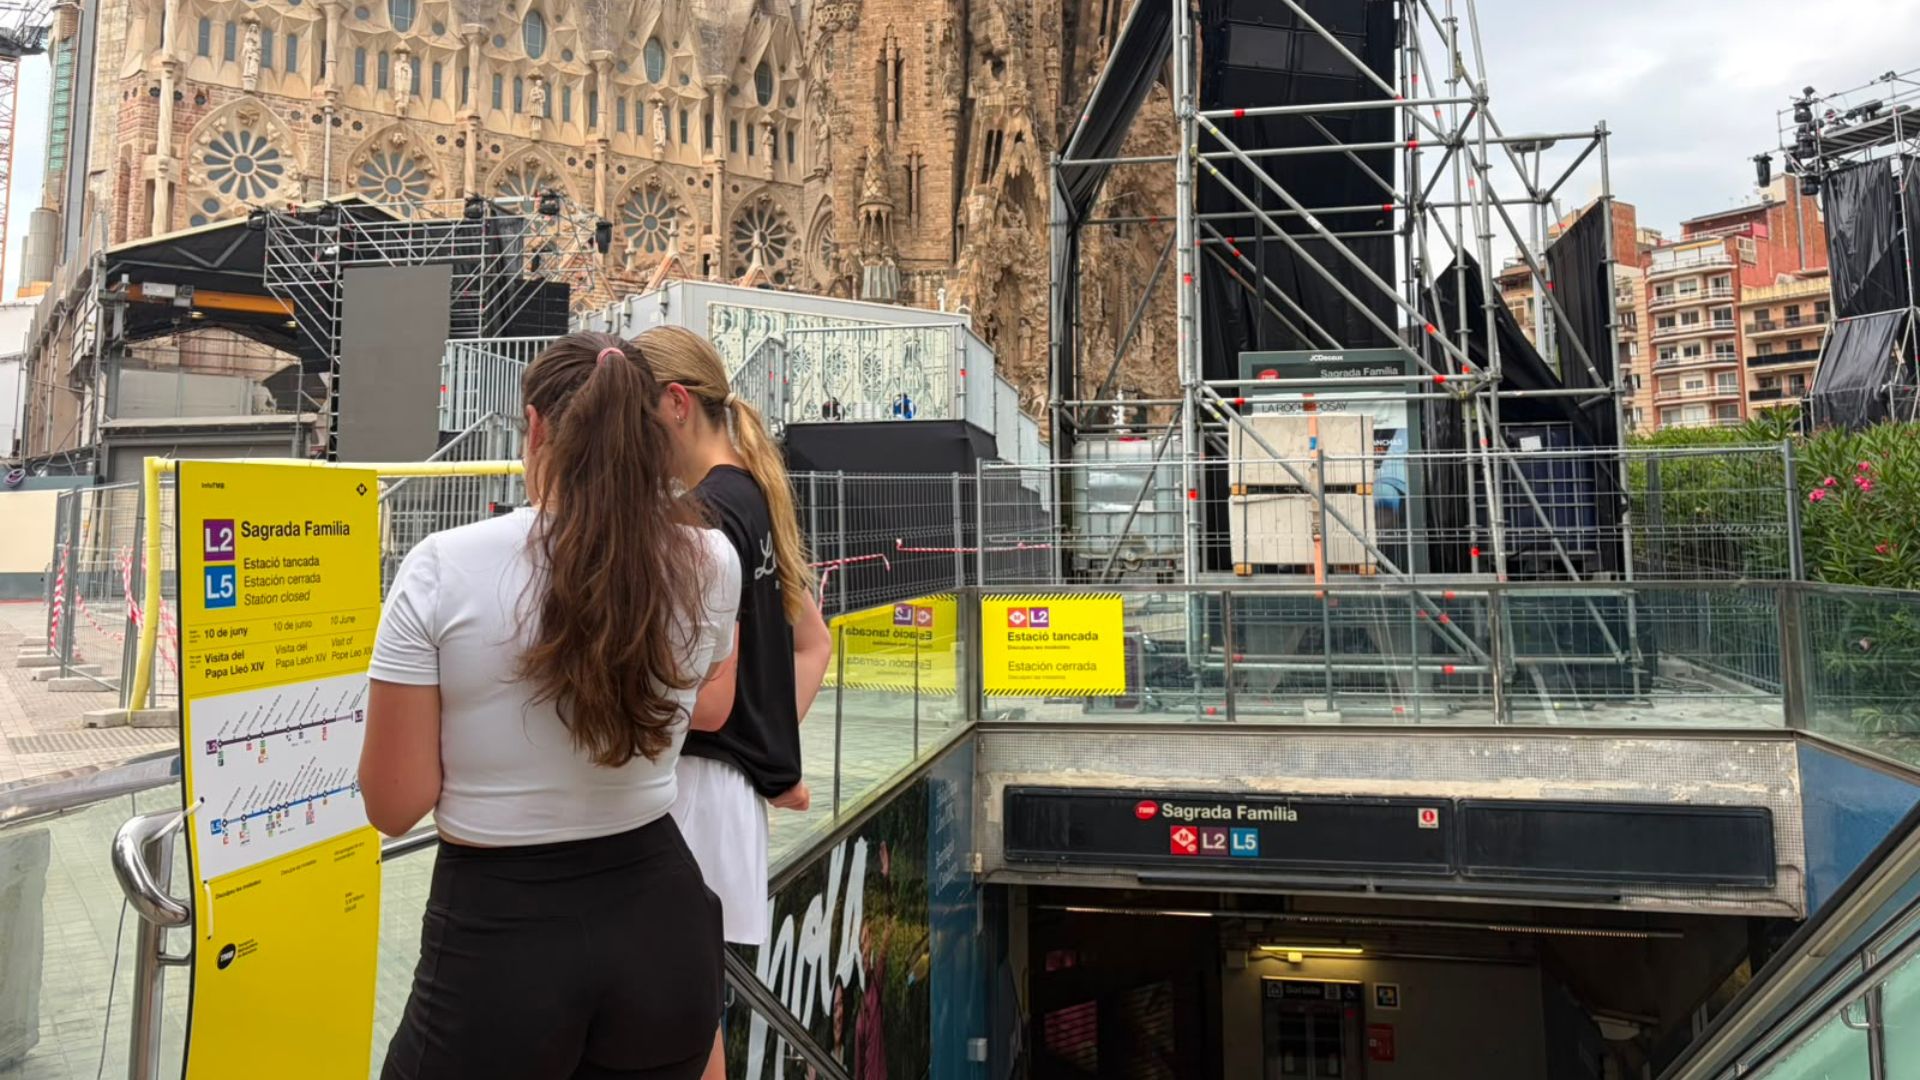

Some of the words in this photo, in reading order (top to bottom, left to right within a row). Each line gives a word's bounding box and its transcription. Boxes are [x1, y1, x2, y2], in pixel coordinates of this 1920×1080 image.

[241, 520, 300, 541] Sagrada
[205, 527, 233, 552] L2
[244, 556, 280, 570] Estació
[283, 555, 320, 568] tancada
[206, 573, 234, 599] L5
[244, 574, 285, 588] Estación
[288, 573, 321, 585] cerrada
[244, 592, 278, 606] Station
[281, 589, 311, 604] closed
[330, 615, 339, 625] 10
[340, 615, 356, 624] June
[1030, 610, 1048, 623] L2
[204, 628, 215, 639] 10
[217, 628, 228, 638] de
[230, 626, 248, 638] juny
[274, 621, 282, 631] 10
[284, 620, 293, 630] de
[295, 619, 312, 631] junio
[331, 636, 345, 648] Visit
[1008, 631, 1049, 642] Estació
[1053, 630, 1099, 641] tancada
[275, 643, 295, 655] Visita
[296, 640, 307, 651] del
[332, 649, 349, 661] Pope
[350, 648, 362, 659] Leo
[204, 652, 229, 664] Visita
[231, 649, 245, 660] del
[275, 657, 295, 669] Papa
[205, 667, 228, 679] Papa
[251, 661, 265, 672] XIV
[1008, 660, 1053, 672] Estación
[1056, 660, 1097, 672] cerrada
[1162, 802, 1232, 821] Sagrada
[1236, 804, 1298, 822] Família
[1202, 832, 1226, 850] L2
[1233, 833, 1258, 850] L5
